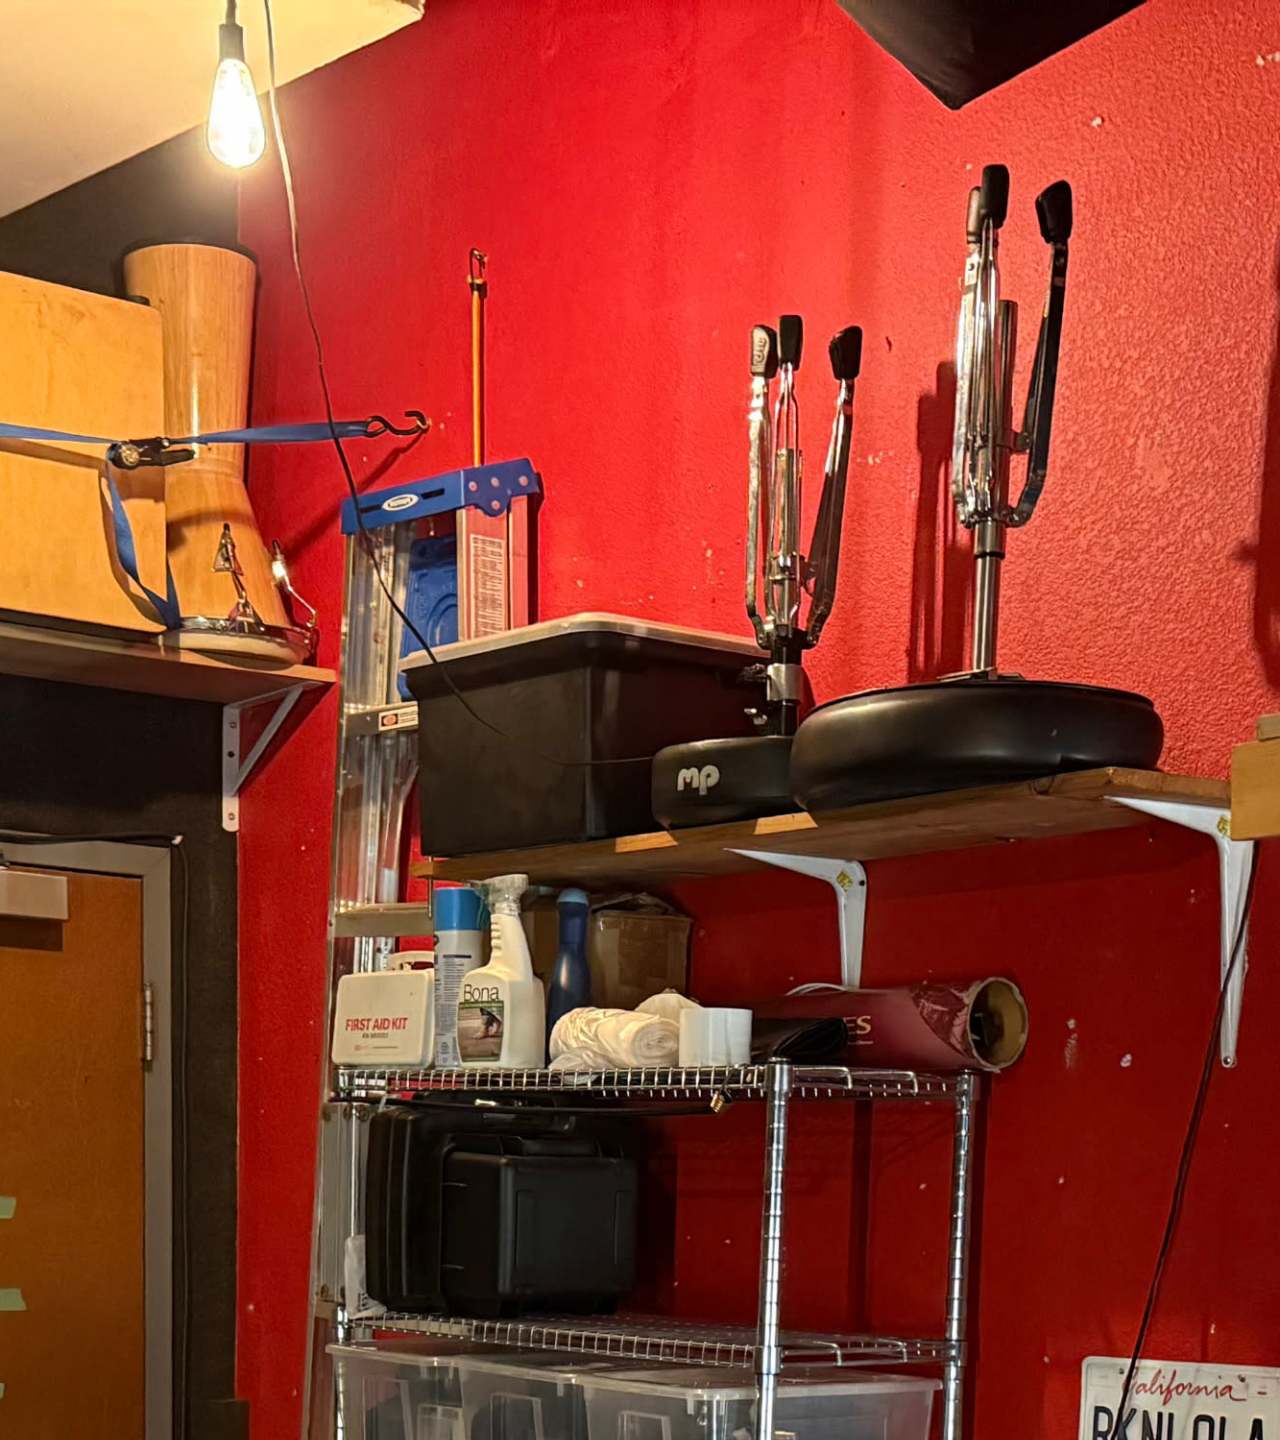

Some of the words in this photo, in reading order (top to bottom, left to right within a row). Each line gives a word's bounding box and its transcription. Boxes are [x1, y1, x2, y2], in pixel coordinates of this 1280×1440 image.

[463, 983, 499, 1001] Bona
[345, 1018, 372, 1032] FIRST
[373, 1017, 391, 1031] AID
[391, 1017, 409, 1030] KIT
[843, 1015, 872, 1035] ES
